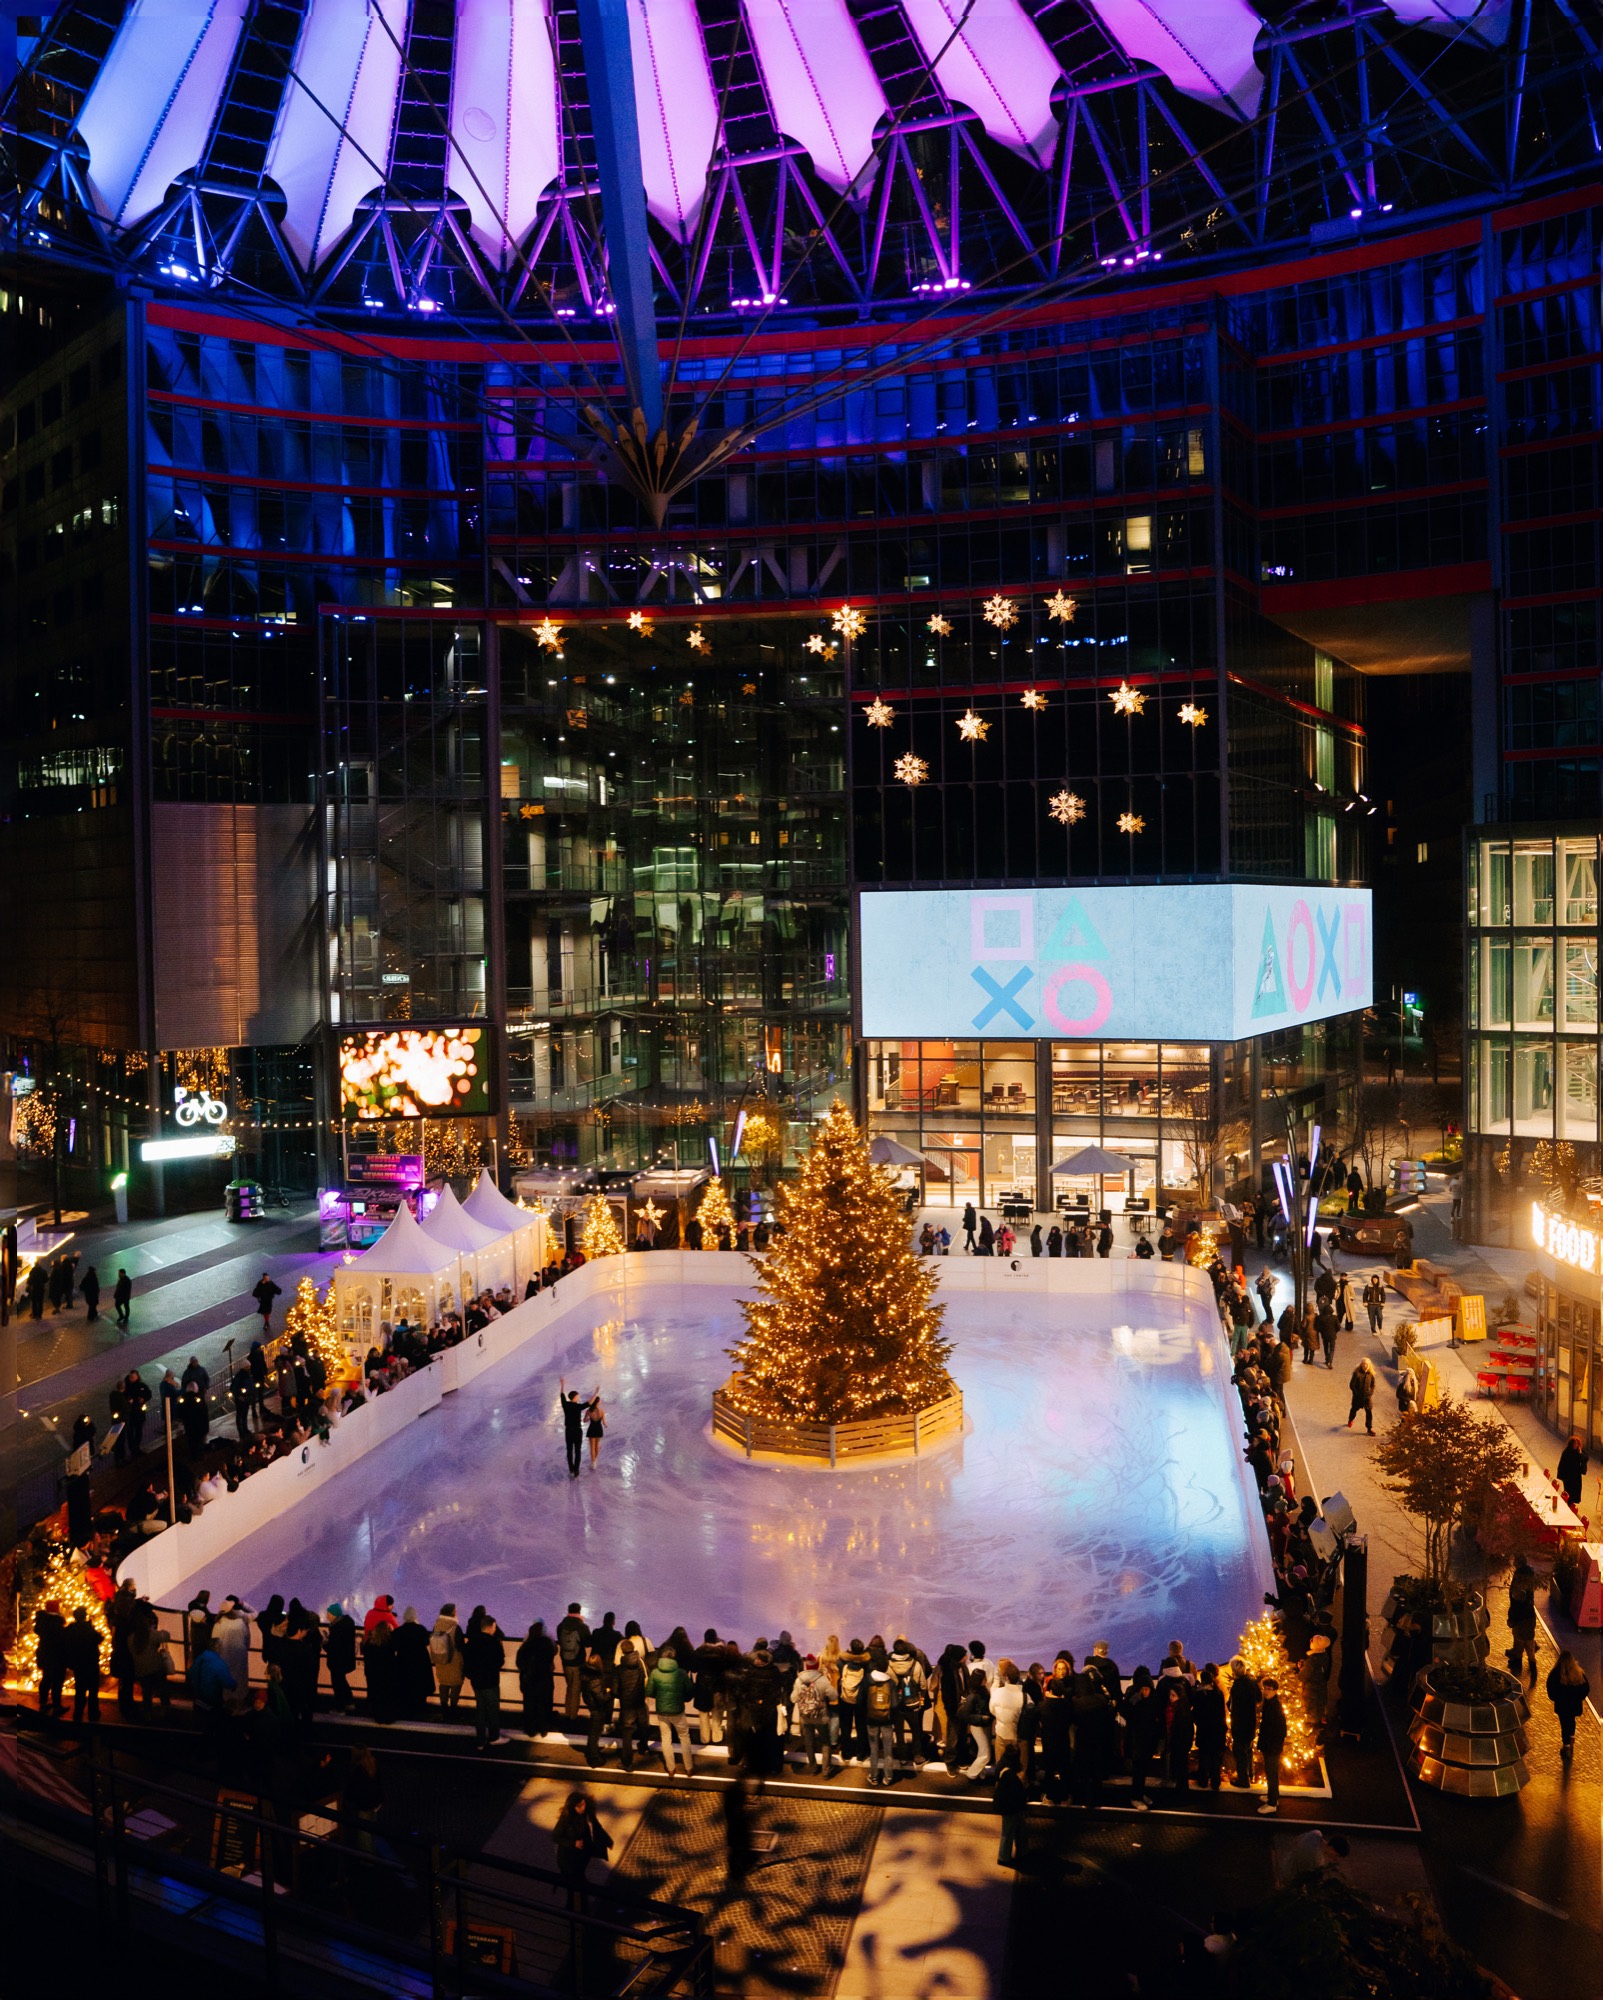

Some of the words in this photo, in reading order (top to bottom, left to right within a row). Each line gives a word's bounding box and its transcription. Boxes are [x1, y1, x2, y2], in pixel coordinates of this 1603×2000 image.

[175, 1087, 187, 1103] P
[362, 1171, 406, 1180] REVOLUTION
[1548, 1217, 1596, 1269] FOOD
